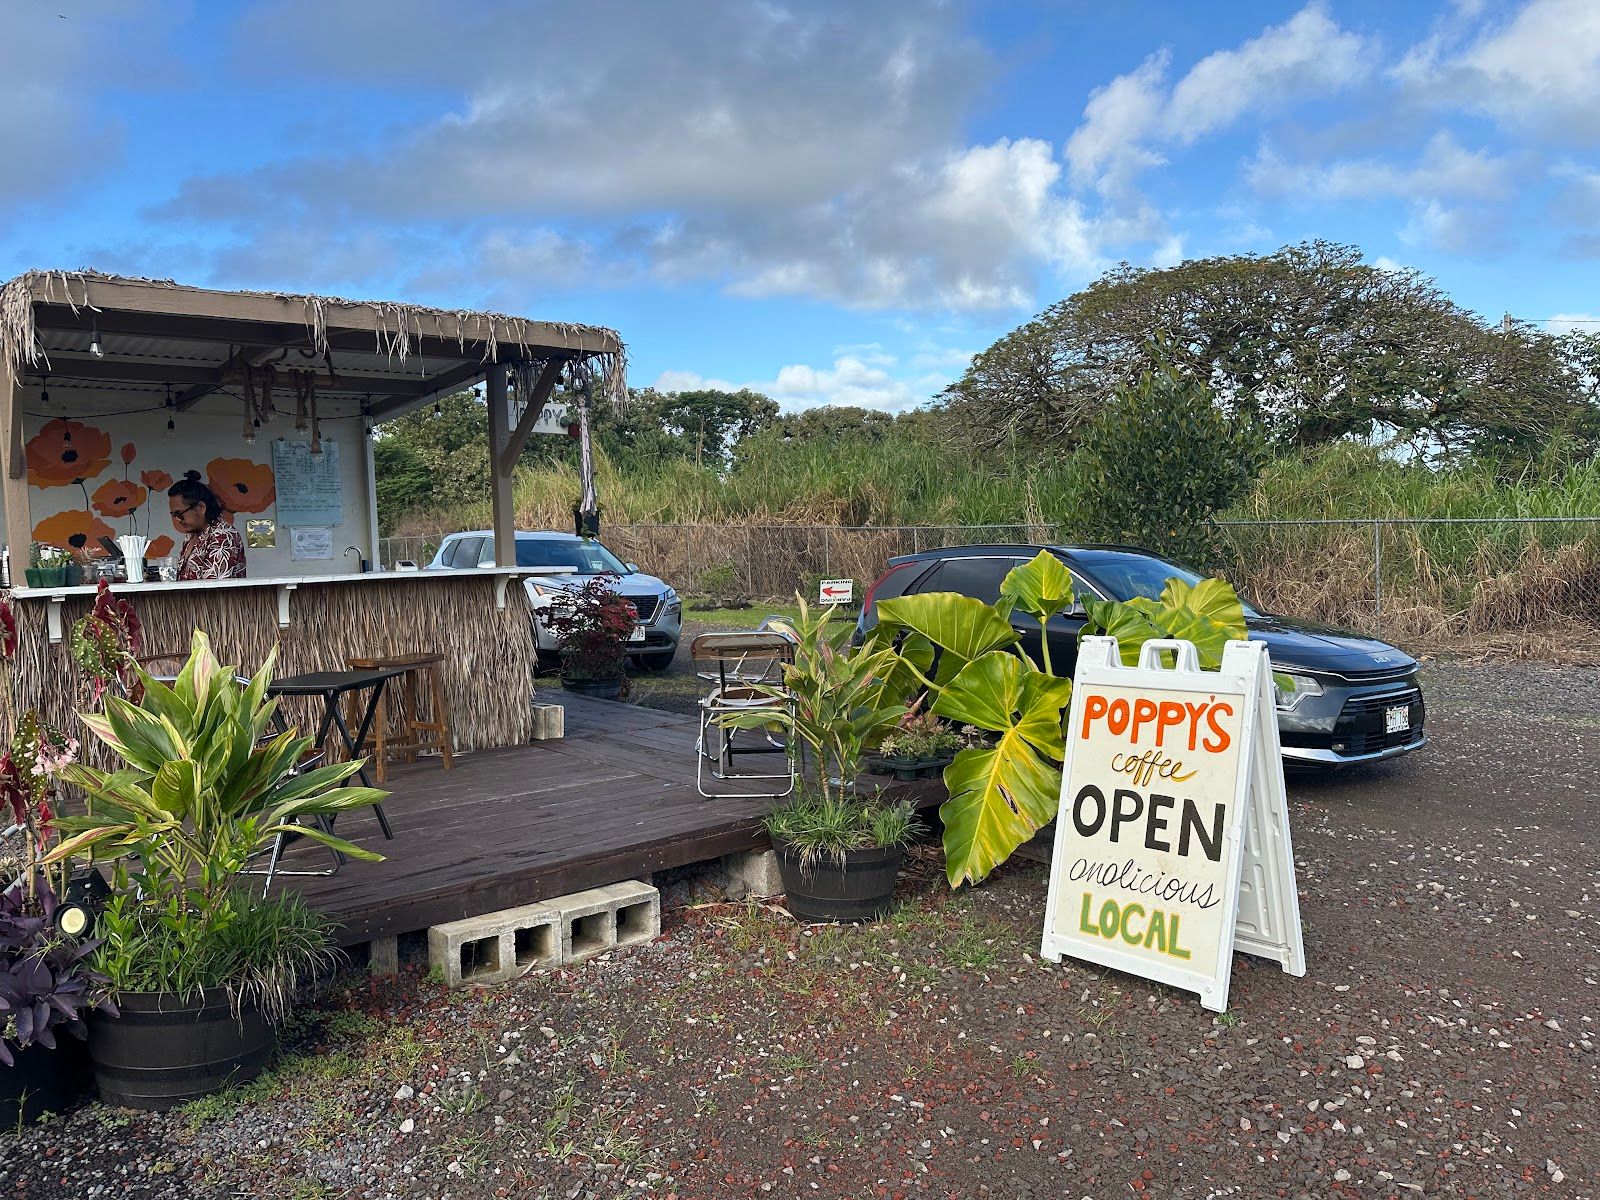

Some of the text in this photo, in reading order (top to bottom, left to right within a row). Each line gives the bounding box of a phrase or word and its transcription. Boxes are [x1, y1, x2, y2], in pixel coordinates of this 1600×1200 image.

[1081, 694, 1234, 753] POPPY'S
[1111, 750, 1197, 786] coffee
[1072, 784, 1226, 862] OPEN
[1079, 891, 1191, 960] LOCAL
